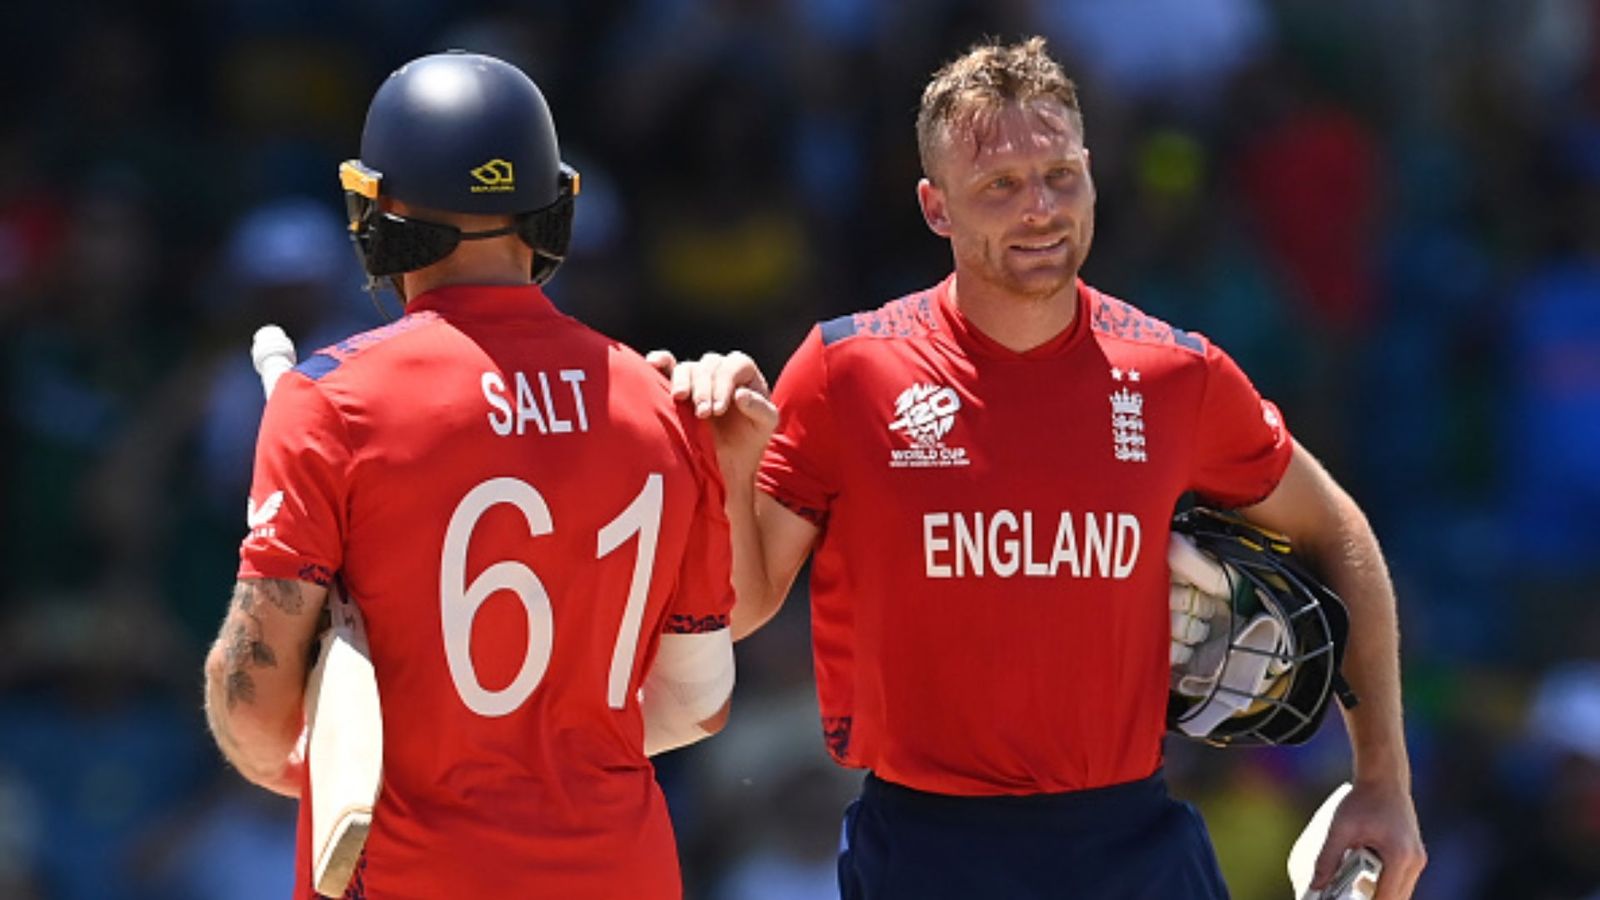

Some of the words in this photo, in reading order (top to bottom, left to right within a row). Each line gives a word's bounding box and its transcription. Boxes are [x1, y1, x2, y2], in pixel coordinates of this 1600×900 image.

[481, 369, 589, 436] SALT
[891, 449, 938, 461] WORLD
[940, 447, 966, 460] CUP
[923, 509, 1142, 579] ENGLAND
[440, 473, 664, 718] 61
